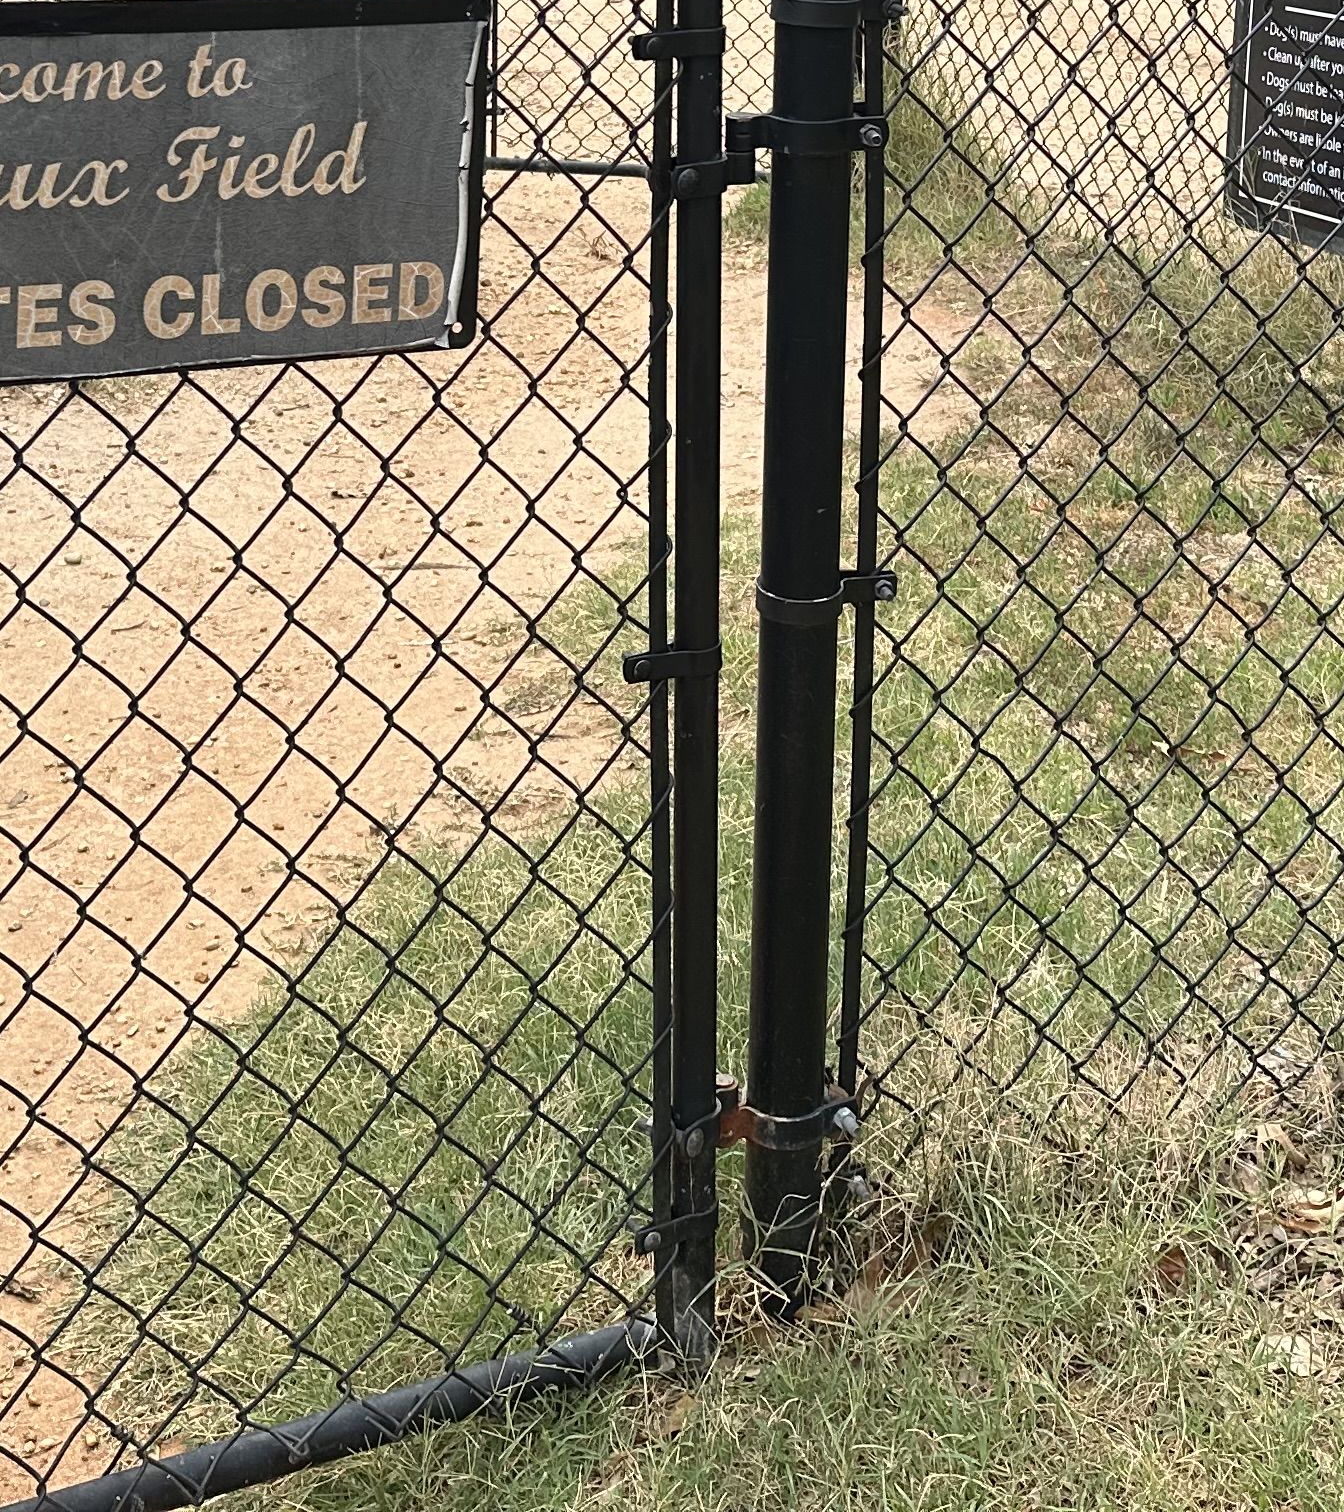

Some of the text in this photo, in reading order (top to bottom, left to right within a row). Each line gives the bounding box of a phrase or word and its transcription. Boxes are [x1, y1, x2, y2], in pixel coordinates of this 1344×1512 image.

[186, 43, 253, 99] to
[1267, 46, 1293, 64] Clean
[1309, 54, 1330, 72] after
[1266, 71, 1290, 92] Dogs
[1293, 79, 1314, 95] must
[1316, 81, 1328, 98] be
[1295, 106, 1319, 122] must
[1320, 107, 1334, 125] be
[1299, 132, 1315, 147] are
[156, 121, 368, 203] Field
[1262, 146, 1272, 161] In
[1272, 149, 1289, 166] the
[1289, 157, 1316, 174] evet
[1316, 160, 1329, 175] of
[1328, 167, 1342, 179] an
[1262, 170, 1297, 188] contact
[143, 261, 446, 340] CLOSED
